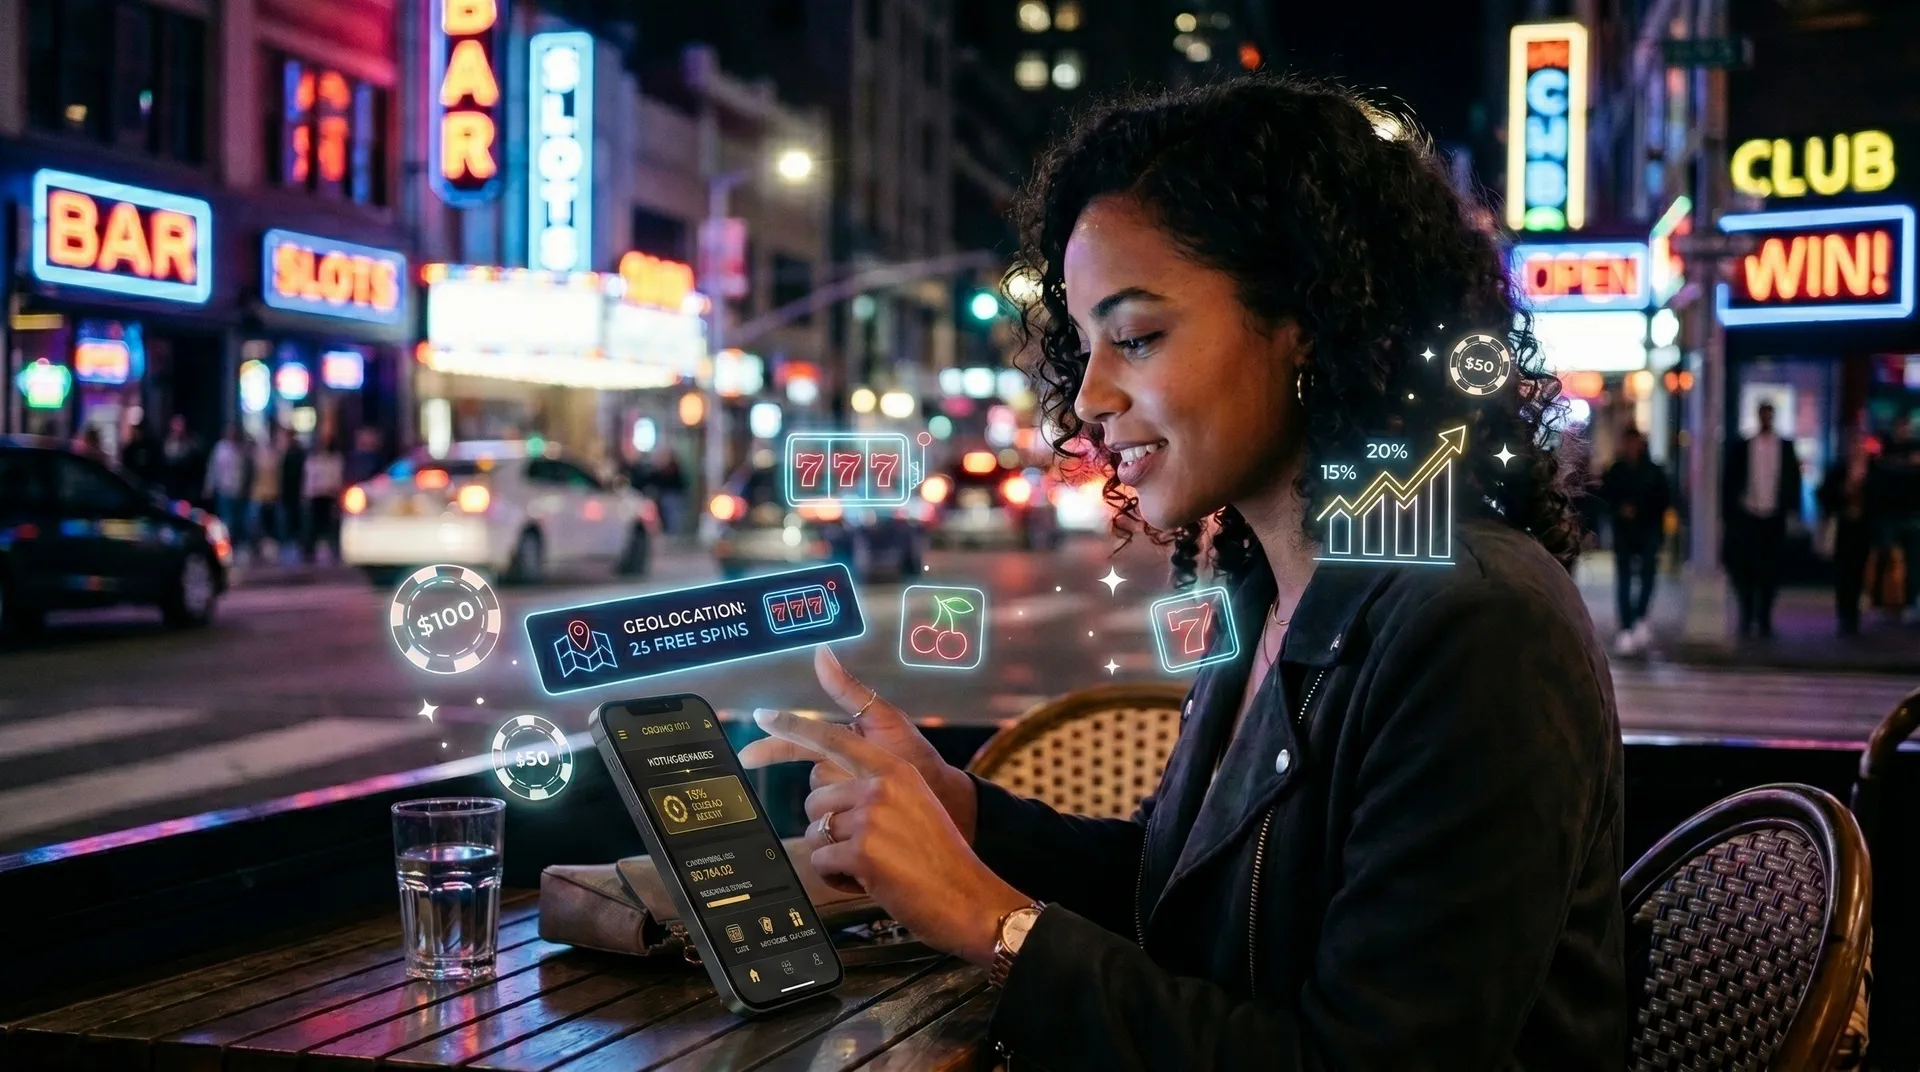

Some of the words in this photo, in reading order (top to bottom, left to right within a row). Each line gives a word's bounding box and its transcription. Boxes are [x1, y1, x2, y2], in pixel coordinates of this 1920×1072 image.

[1731, 130, 1896, 197] CLUB
[48, 189, 197, 285] BAR
[1745, 230, 1892, 301] WIN!
[273, 241, 399, 311] SLOTS
[1524, 254, 1639, 301] OPEN
